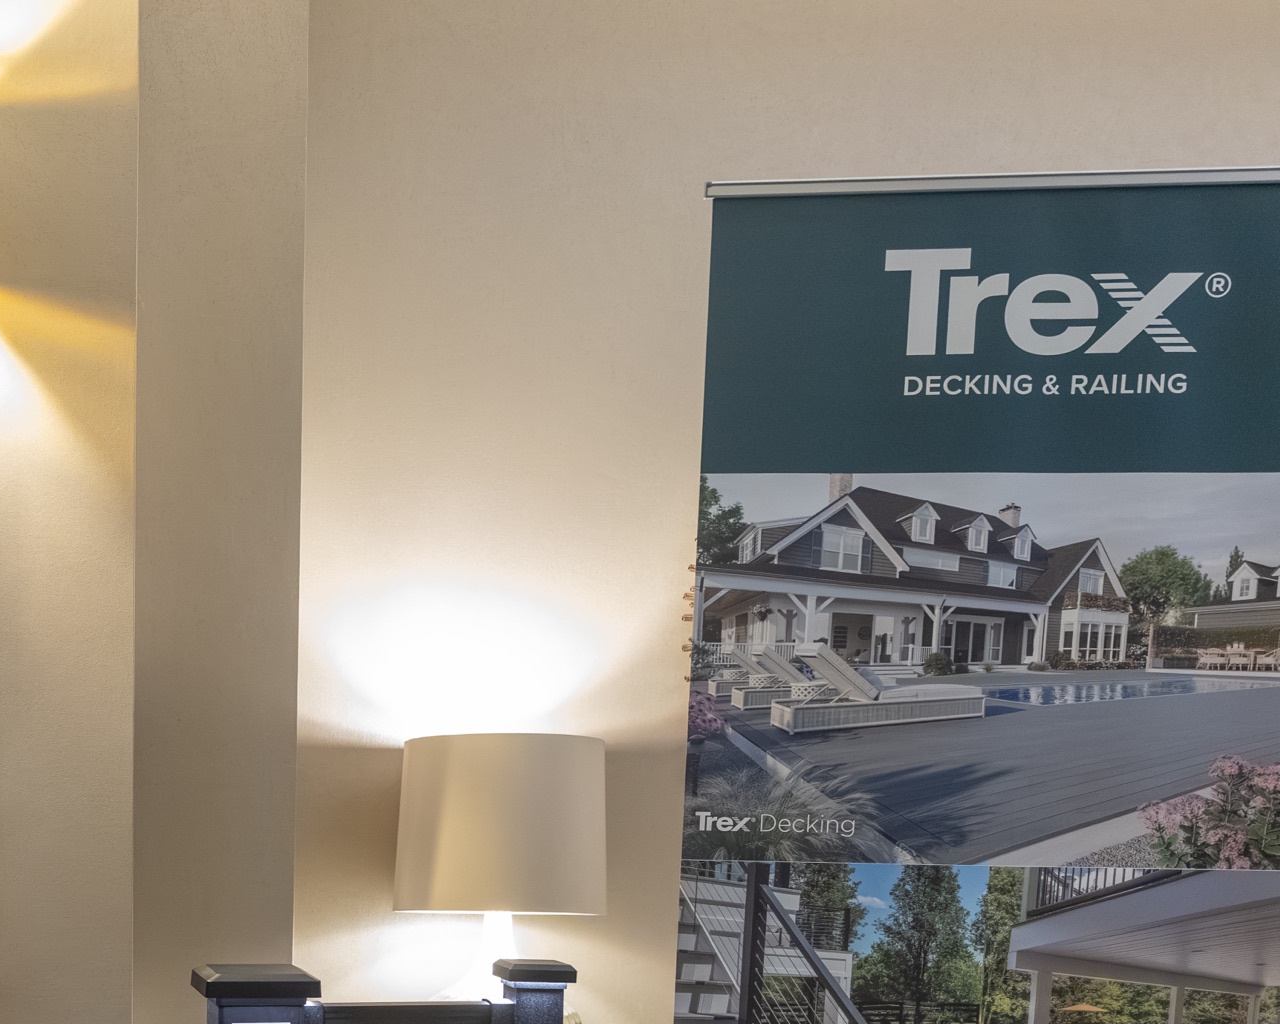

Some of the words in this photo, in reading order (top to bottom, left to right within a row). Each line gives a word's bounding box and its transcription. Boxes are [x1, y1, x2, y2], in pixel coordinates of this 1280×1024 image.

[904, 374, 1033, 396] DECKING
[1042, 375, 1060, 395] &
[1070, 373, 1188, 395] RAILING
[760, 814, 856, 837] Decking
